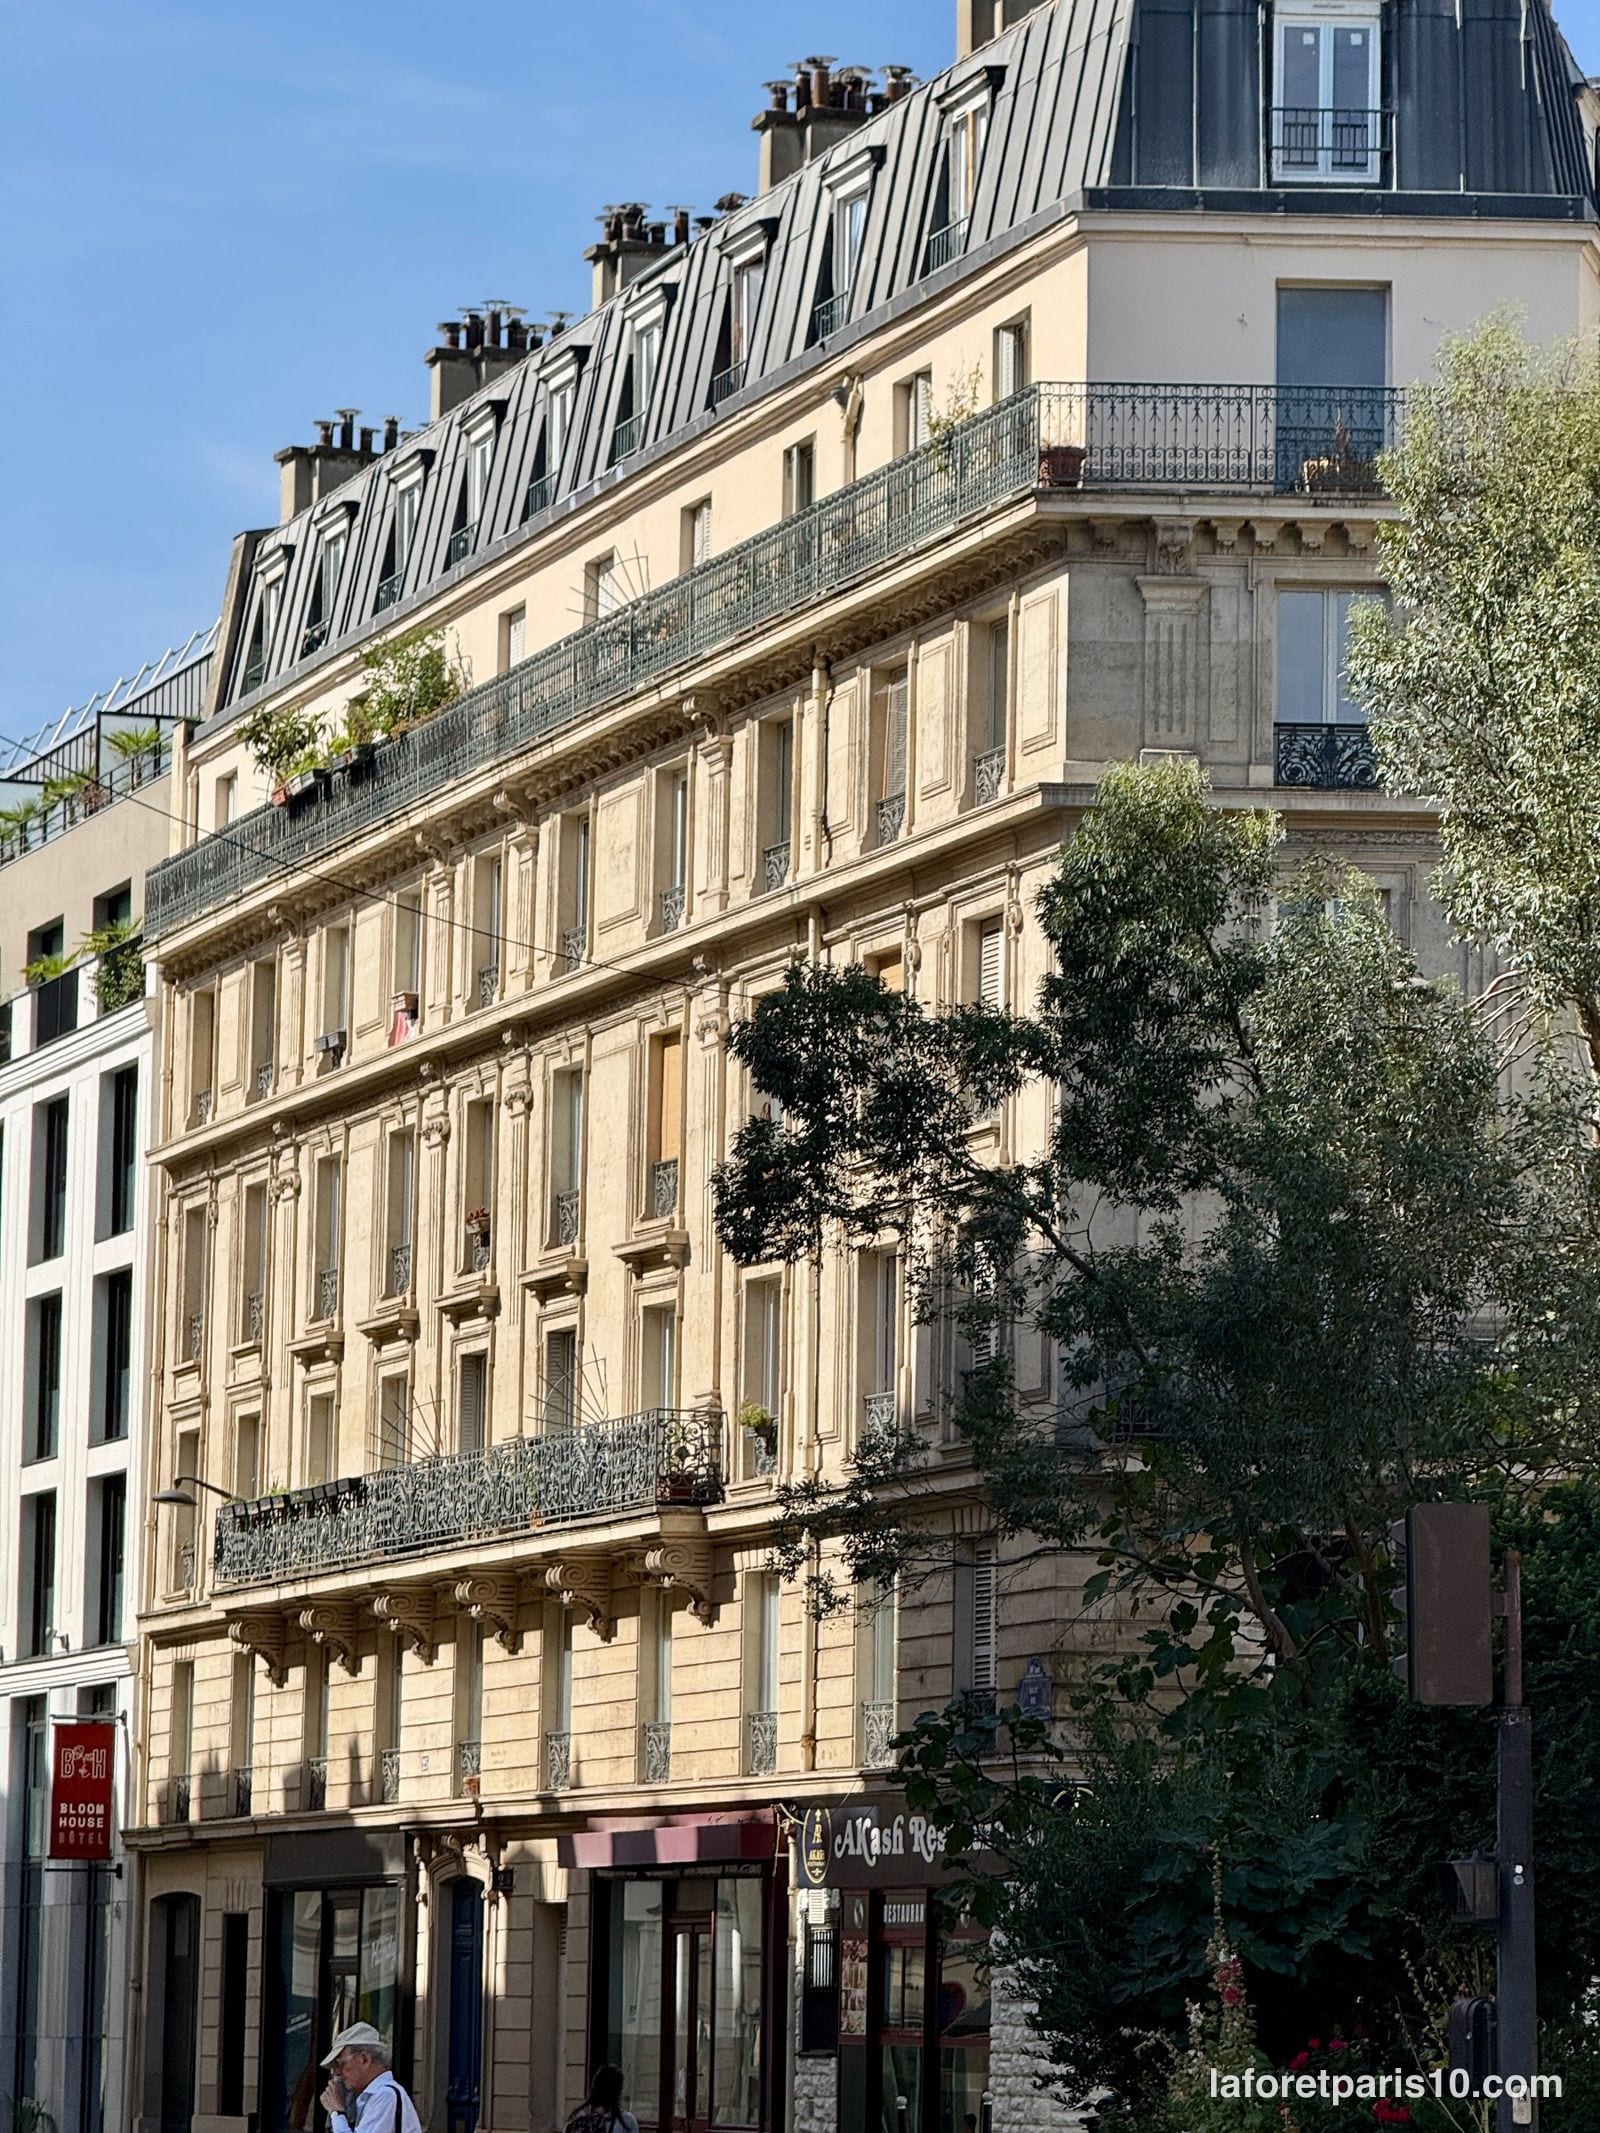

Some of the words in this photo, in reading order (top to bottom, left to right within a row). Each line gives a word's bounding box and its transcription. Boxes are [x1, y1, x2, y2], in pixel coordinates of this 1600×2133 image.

[60, 1802, 104, 1815] BLOOM
[59, 1816, 104, 1828] HOUSE
[883, 1903, 925, 1924] RESTAURAN
